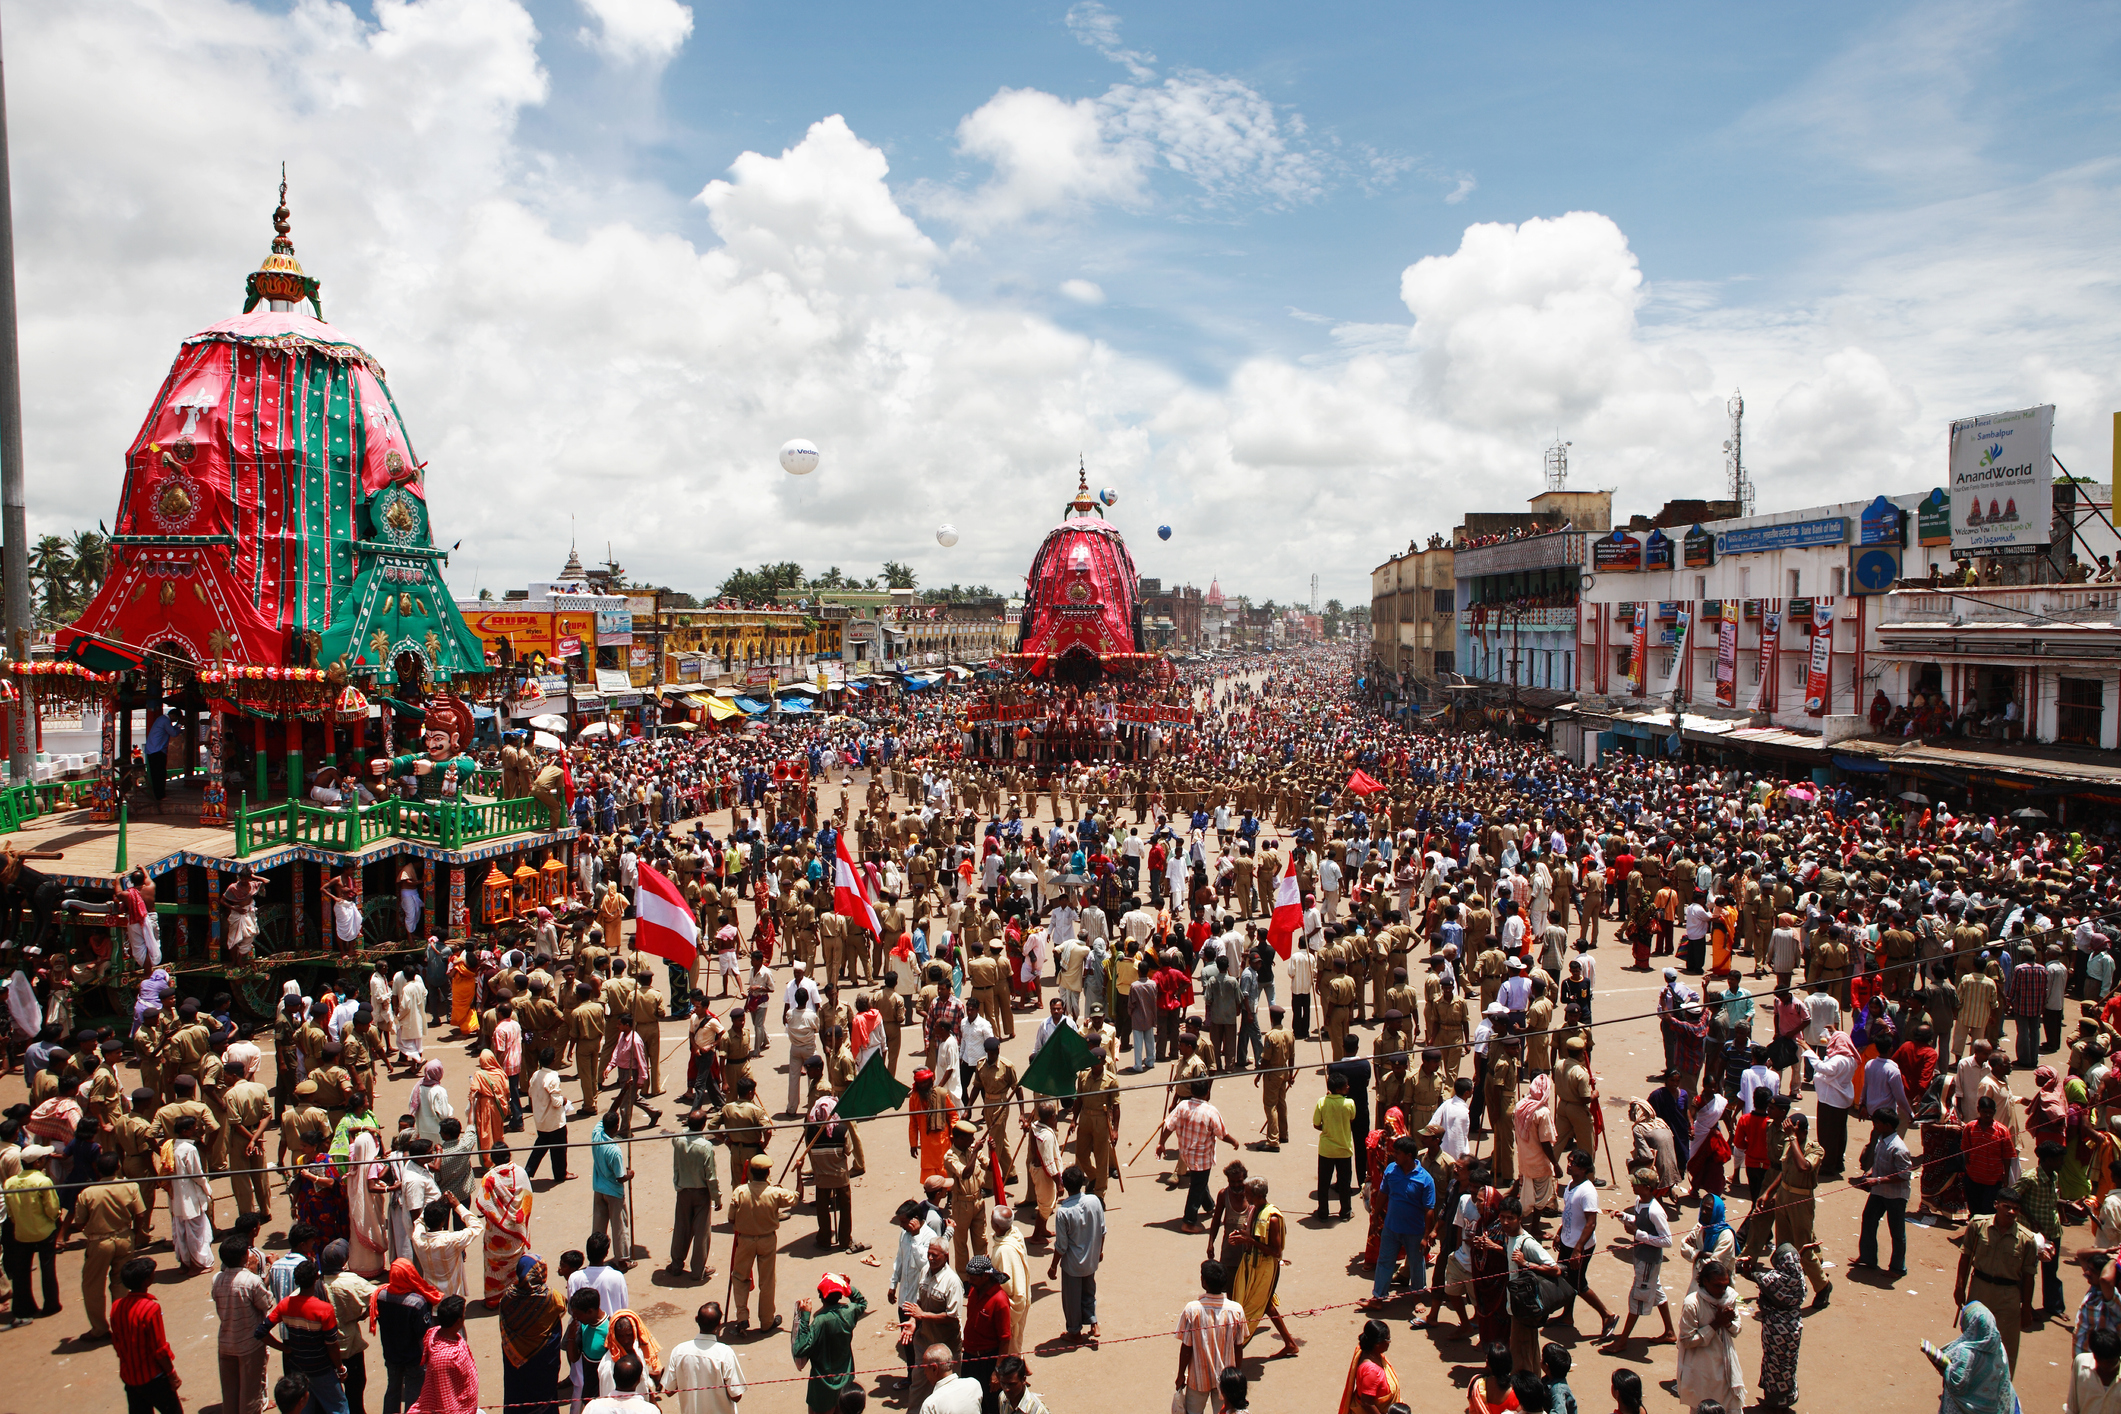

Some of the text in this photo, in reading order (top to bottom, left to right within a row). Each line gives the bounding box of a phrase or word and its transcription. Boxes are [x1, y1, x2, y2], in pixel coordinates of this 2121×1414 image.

[2022, 411, 2036, 419] Mall
[1977, 429, 2014, 440] Sambalpur
[1956, 463, 2032, 485] AnandWorld
[1801, 526, 1812, 536] State
[1812, 524, 1823, 534] Bank
[1829, 522, 1840, 532] India
[1980, 525, 1990, 533] You
[492, 616, 538, 625] RUPA
